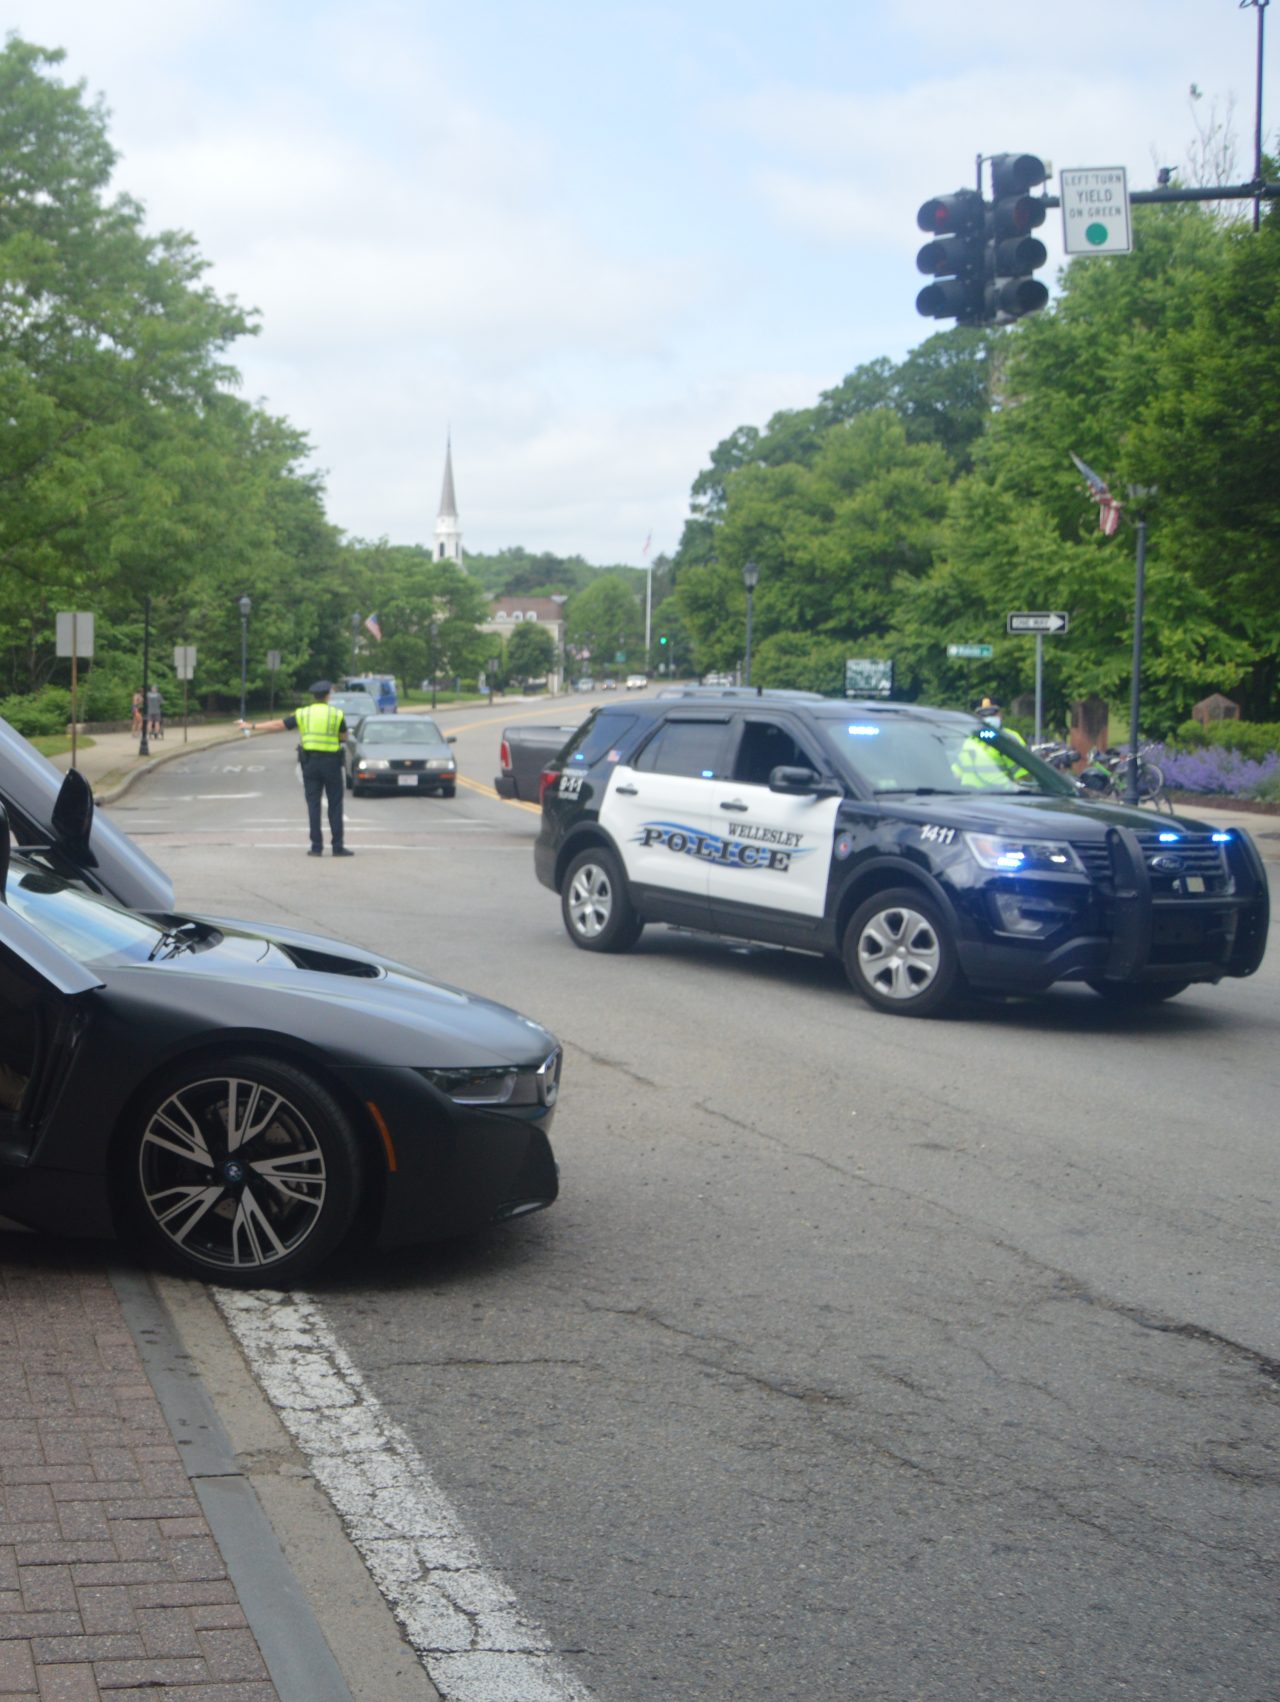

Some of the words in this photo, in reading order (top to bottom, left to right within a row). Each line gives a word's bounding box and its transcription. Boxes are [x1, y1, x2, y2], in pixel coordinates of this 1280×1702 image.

[1064, 175, 1089, 187] LEFT
[1092, 173, 1123, 184] TURN
[1077, 189, 1113, 203] YIELD
[1069, 208, 1083, 218] ON
[1088, 206, 1122, 217] GREEN
[728, 822, 804, 848] WELLESLEY
[920, 824, 955, 845] 1411
[639, 827, 792, 872] POLICE
